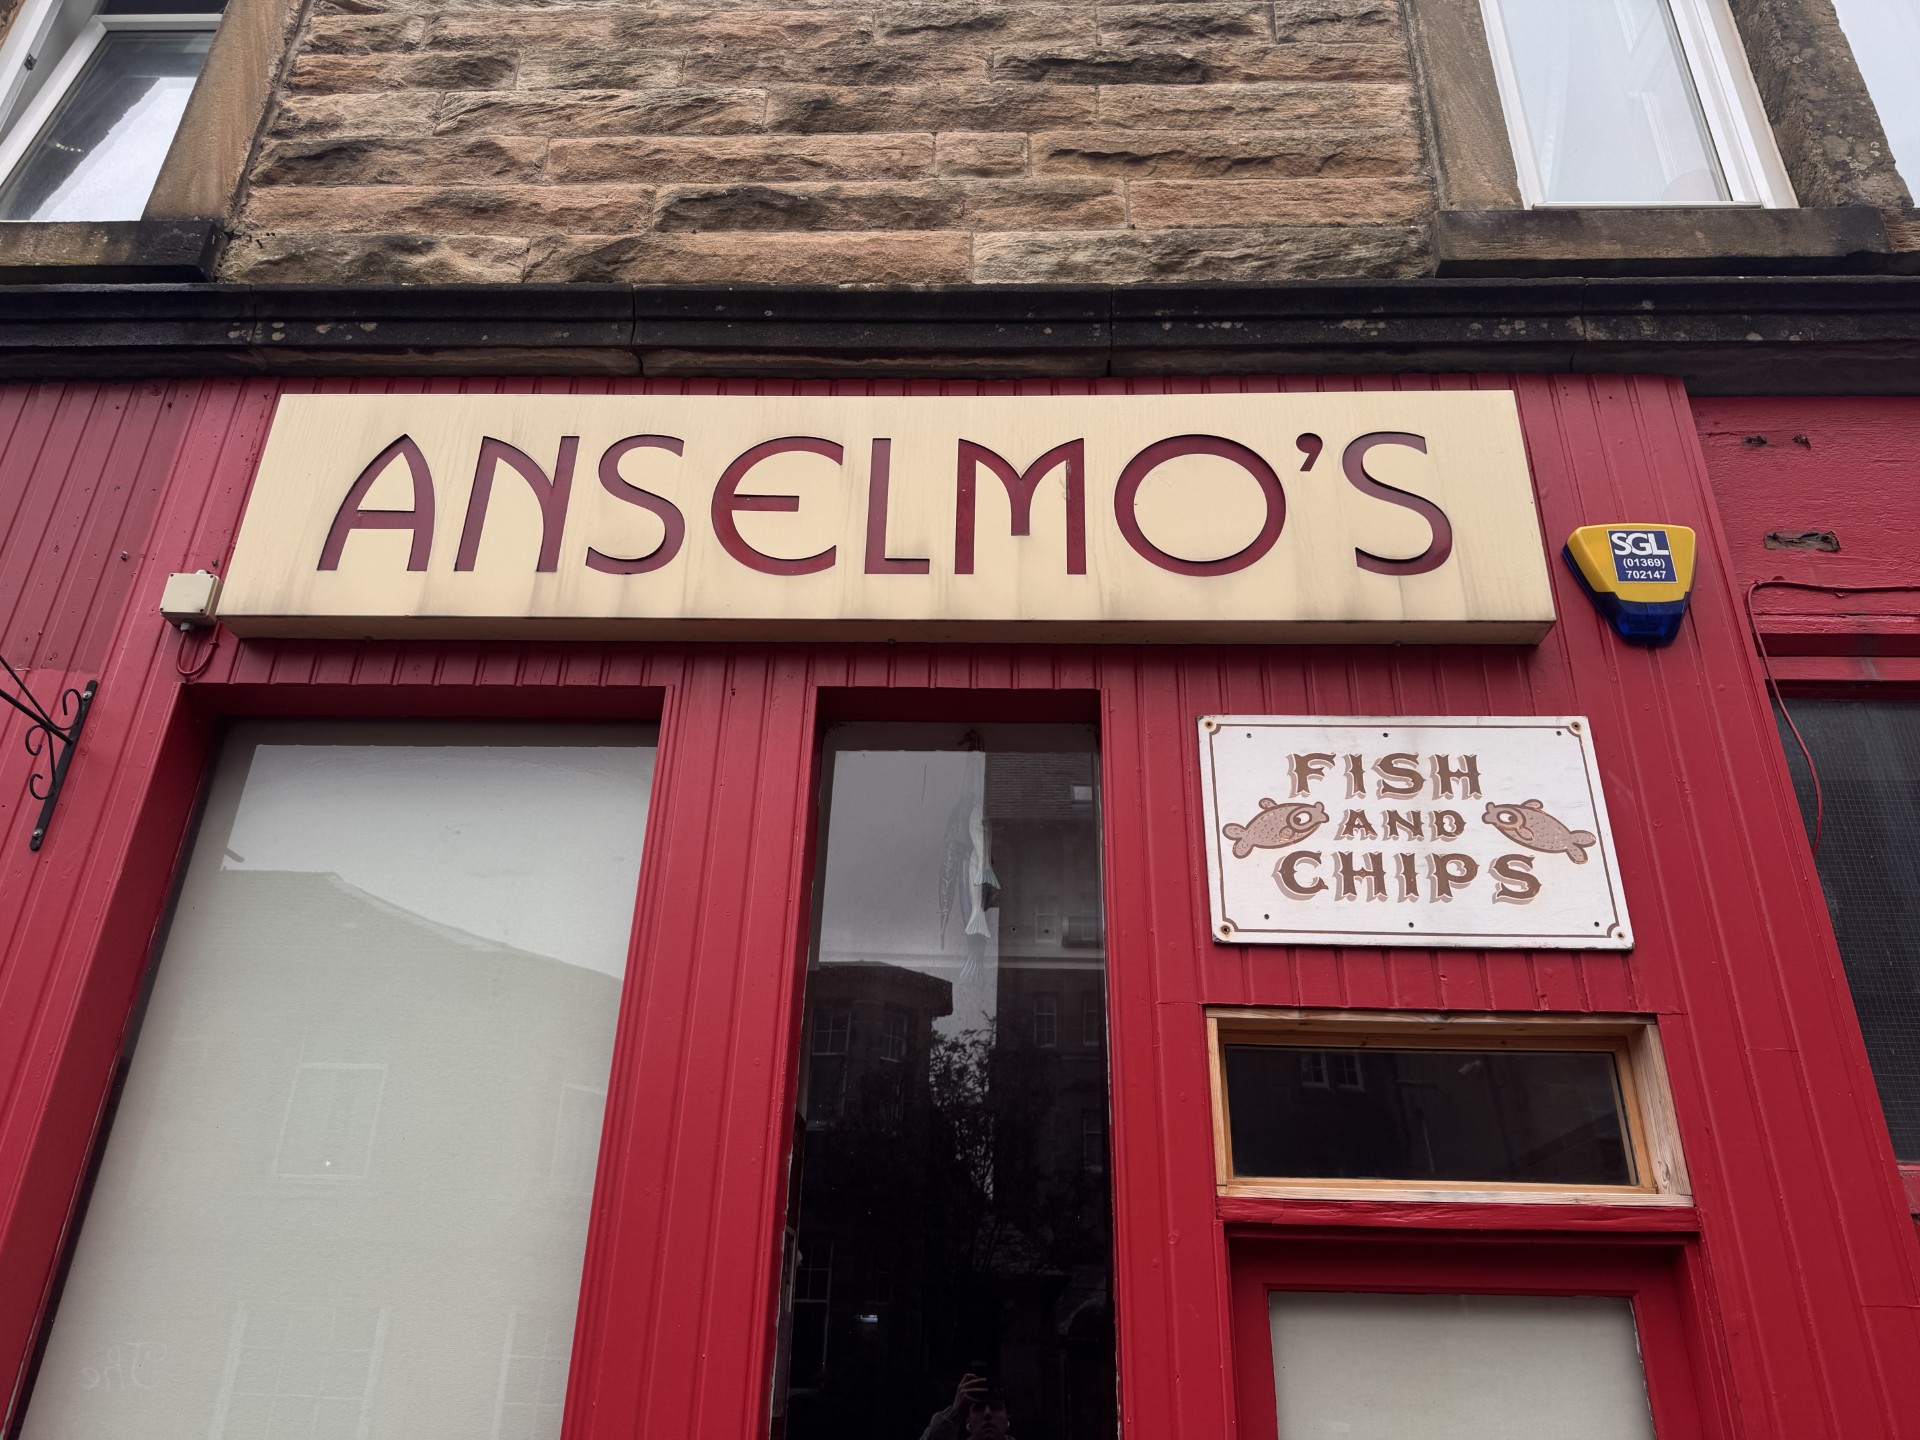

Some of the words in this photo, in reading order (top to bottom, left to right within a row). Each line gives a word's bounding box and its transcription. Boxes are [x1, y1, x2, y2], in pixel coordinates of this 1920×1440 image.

[1611, 532, 1670, 556] SGL
[1623, 558, 1666, 569] (01369)
[1625, 570, 1667, 579] 702147
[1286, 752, 1483, 800] FISH
[1334, 808, 1467, 842] AND
[1272, 850, 1543, 906] CHIPS
